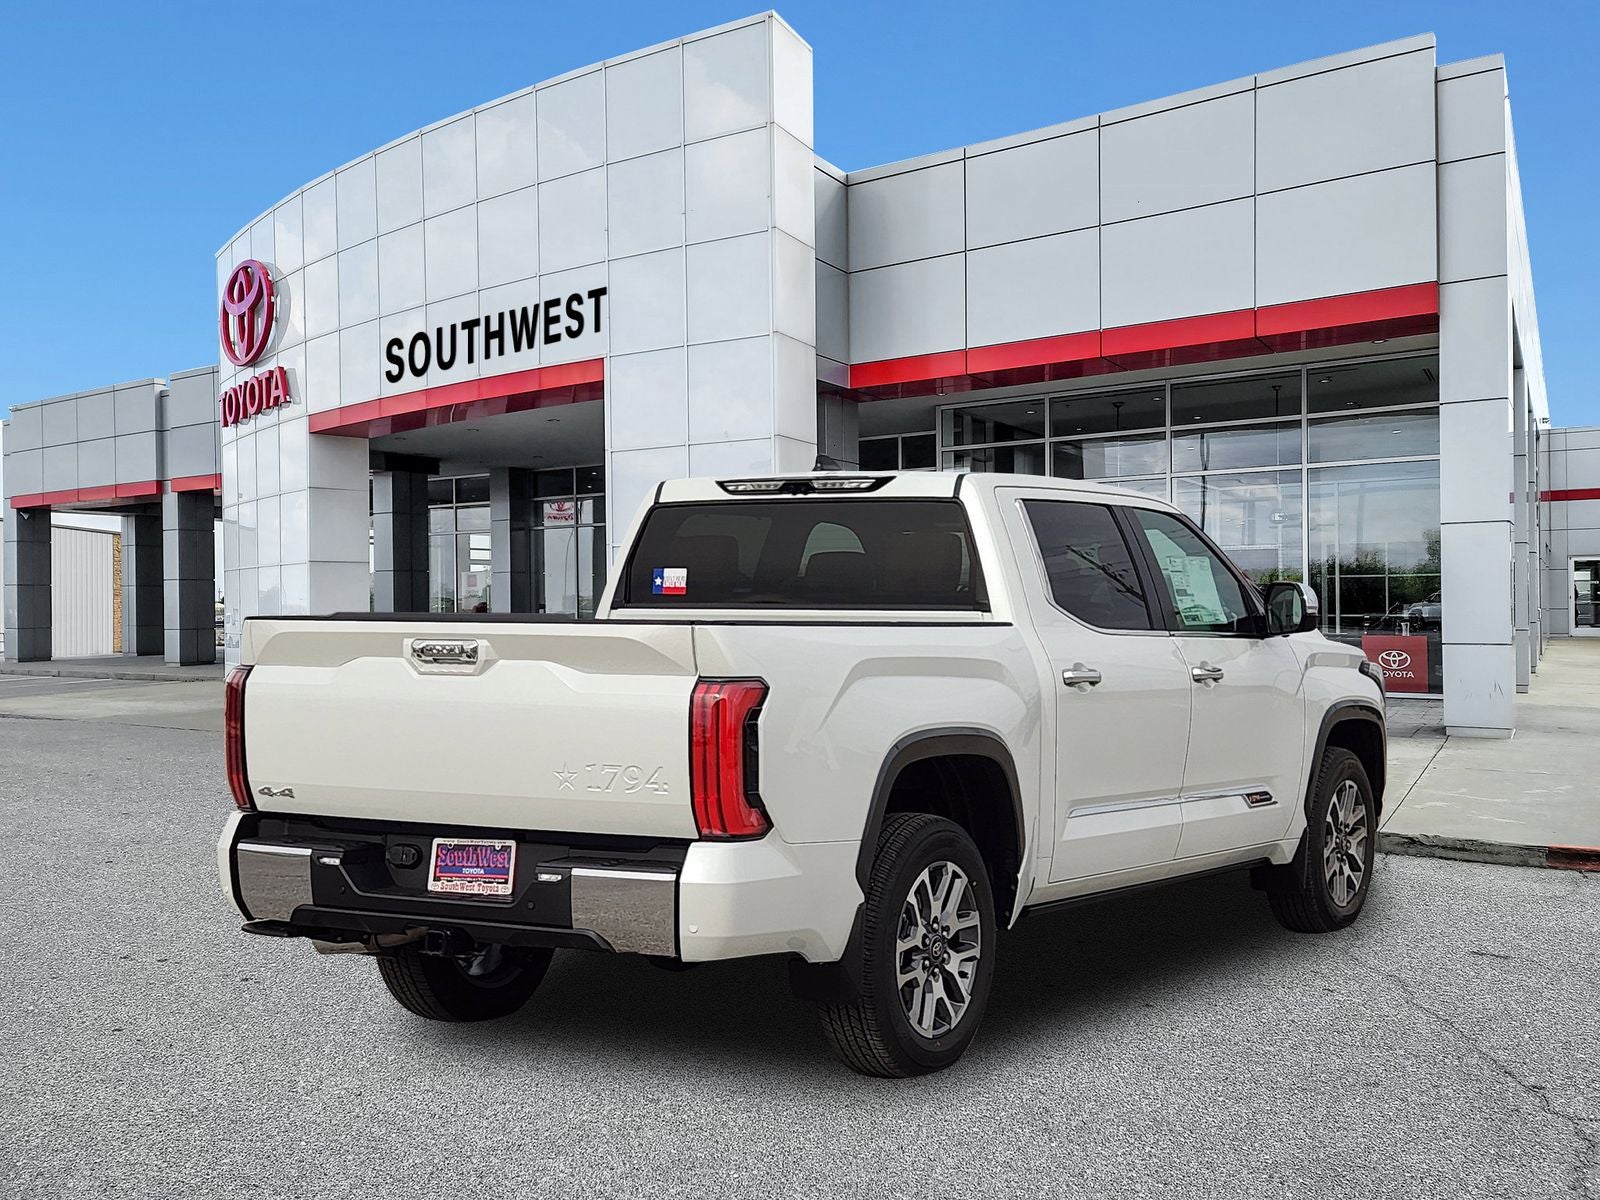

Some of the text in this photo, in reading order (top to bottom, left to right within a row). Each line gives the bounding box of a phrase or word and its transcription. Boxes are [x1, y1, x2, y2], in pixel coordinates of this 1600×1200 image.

[385, 286, 607, 383] SOUTHWEST
[219, 366, 291, 428] TOYOTA
[584, 763, 669, 795] 1794
[477, 883, 499, 894] Toyota
